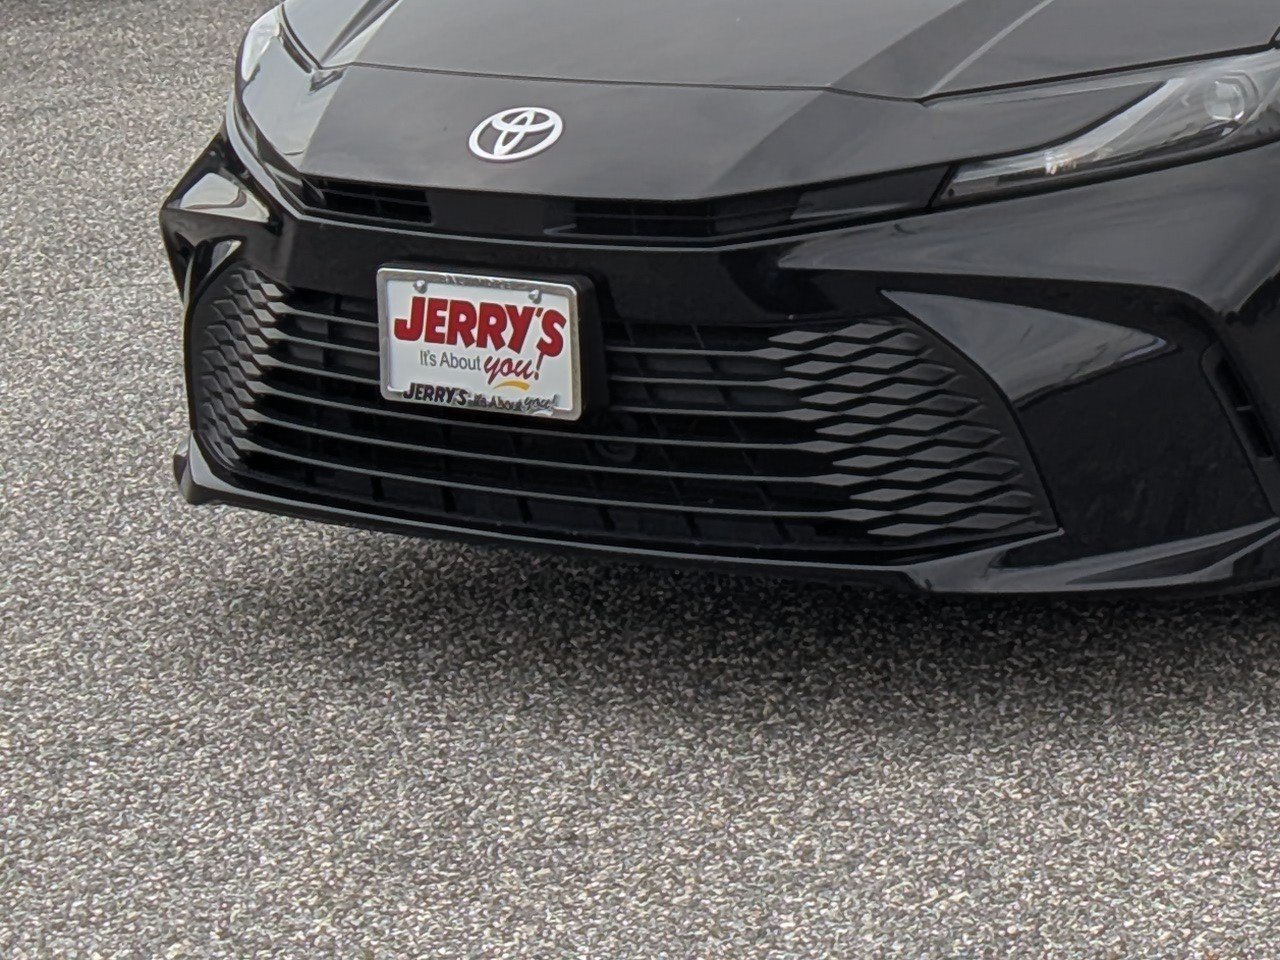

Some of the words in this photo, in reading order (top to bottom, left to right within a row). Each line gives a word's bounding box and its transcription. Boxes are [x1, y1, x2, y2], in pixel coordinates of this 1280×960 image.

[394, 295, 568, 358] JERRY'S
[419, 349, 437, 367] It's
[440, 352, 481, 371] About
[484, 351, 545, 386] you!
[402, 382, 470, 407] JERRY'S
